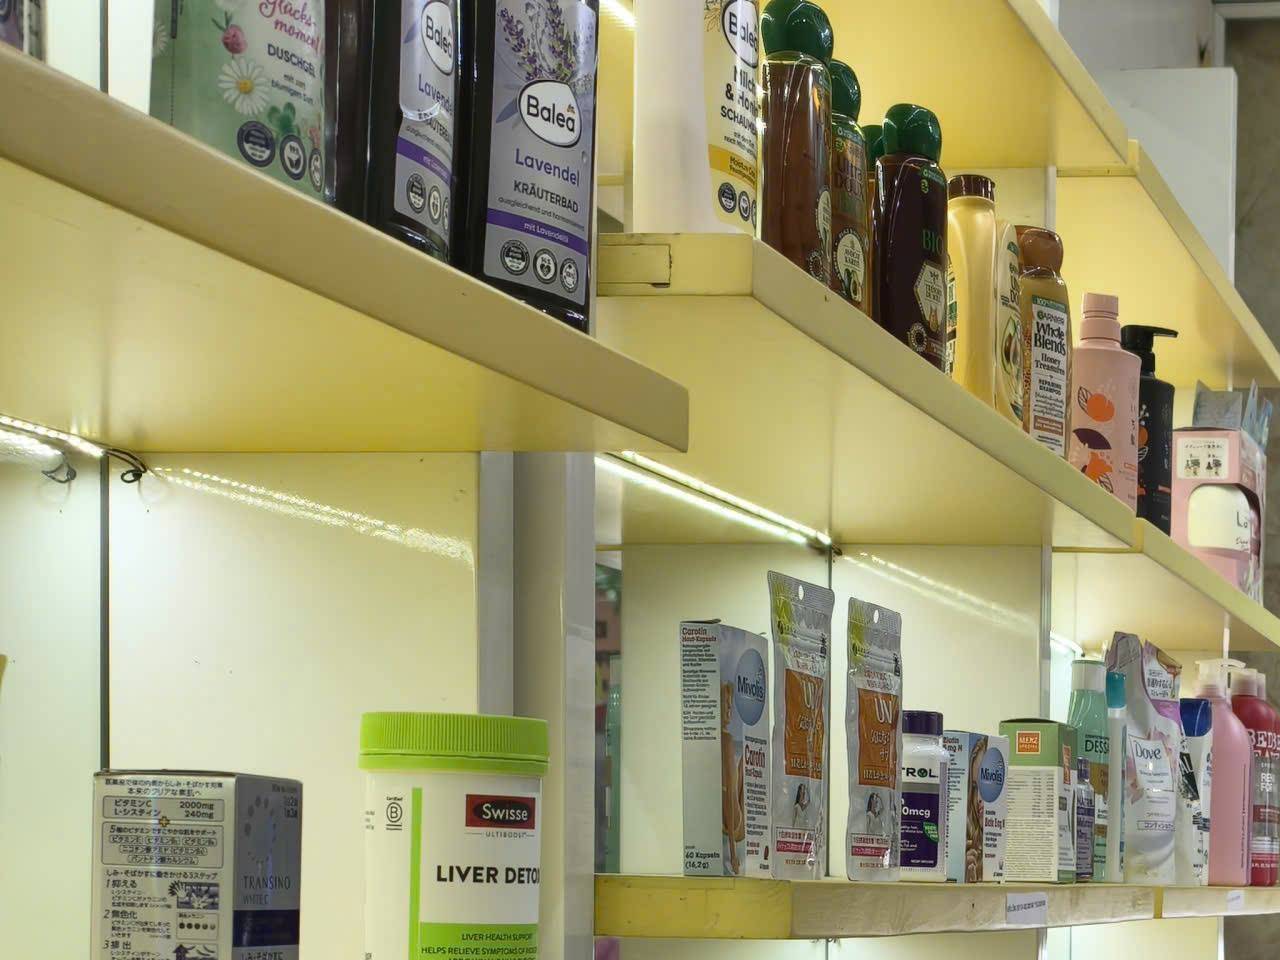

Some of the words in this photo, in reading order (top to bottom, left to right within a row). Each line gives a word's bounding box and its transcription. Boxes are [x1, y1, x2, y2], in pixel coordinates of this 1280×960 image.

[527, 94, 575, 133] Balea
[515, 148, 580, 187] Lavendel
[513, 180, 579, 213] KRÄUTERBAD
[1036, 321, 1065, 341] Whole
[1034, 334, 1066, 356] Blends
[1041, 352, 1061, 367] Honey
[682, 627, 707, 636] Carotin
[737, 675, 764, 699] Mivolis
[1019, 736, 1039, 745] MERZ
[1134, 741, 1161, 760] Dove
[180, 801, 214, 810] 2000mg
[482, 803, 528, 821] Swisse
[184, 810, 214, 819] 240mg
[696, 852, 720, 860] Kapseln
[243, 875, 291, 890] TRANSINO
[436, 865, 499, 884] LIVER
[462, 933, 484, 941] LIVER
[485, 933, 511, 941] HEALTH
[421, 946, 447, 955] HELPS
[448, 947, 480, 955] RELIEVE
